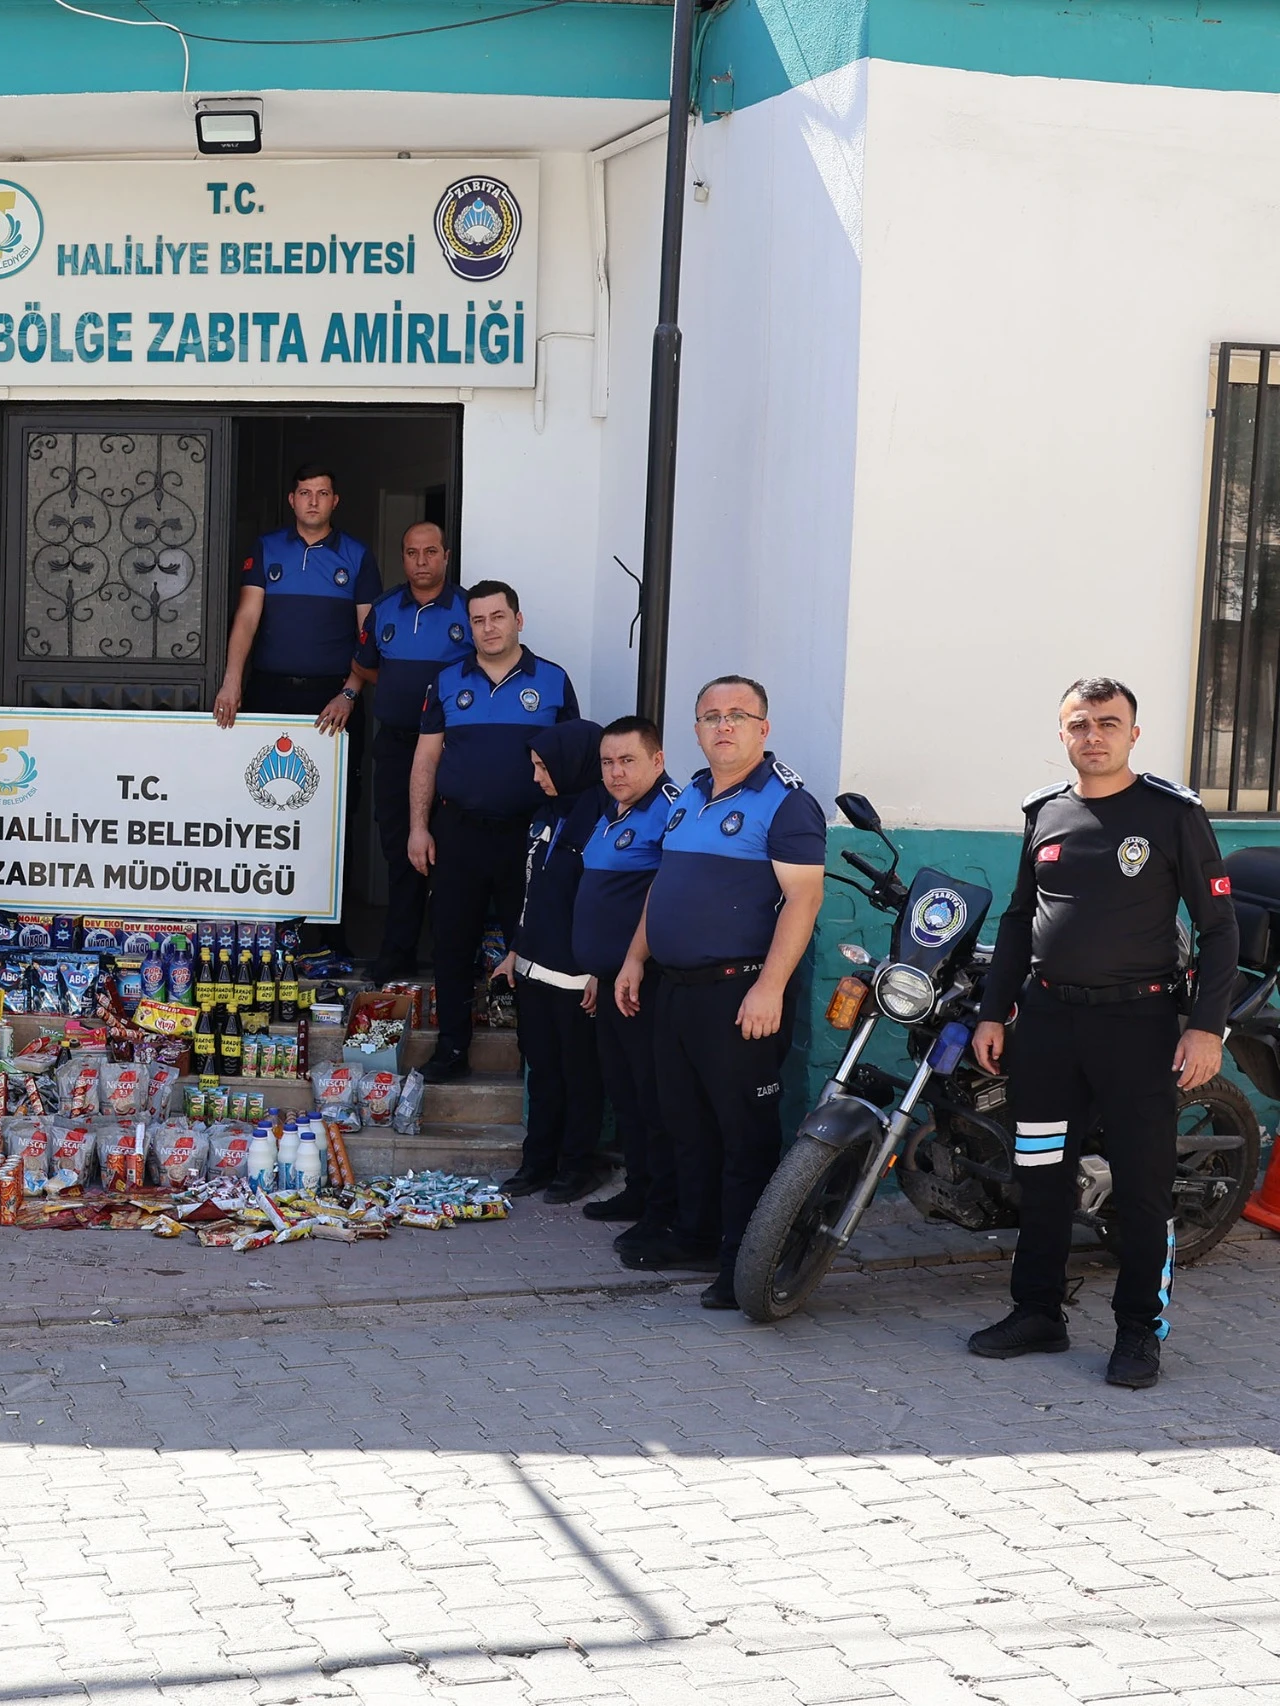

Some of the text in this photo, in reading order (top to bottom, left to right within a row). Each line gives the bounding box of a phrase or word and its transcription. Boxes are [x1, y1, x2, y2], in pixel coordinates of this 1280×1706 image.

[207, 182, 264, 215] T.C.
[454, 181, 501, 199] ZABITA
[57, 233, 415, 276] HALİLİYE BELEDİYESİ
[147, 312, 308, 363] ZABITA
[321, 300, 523, 364] AMİRLİĞİ
[117, 775, 168, 801] T.C.
[127, 818, 301, 851] BELEDİYESİ
[104, 859, 295, 896] MÜDÜRLÜĞÜ
